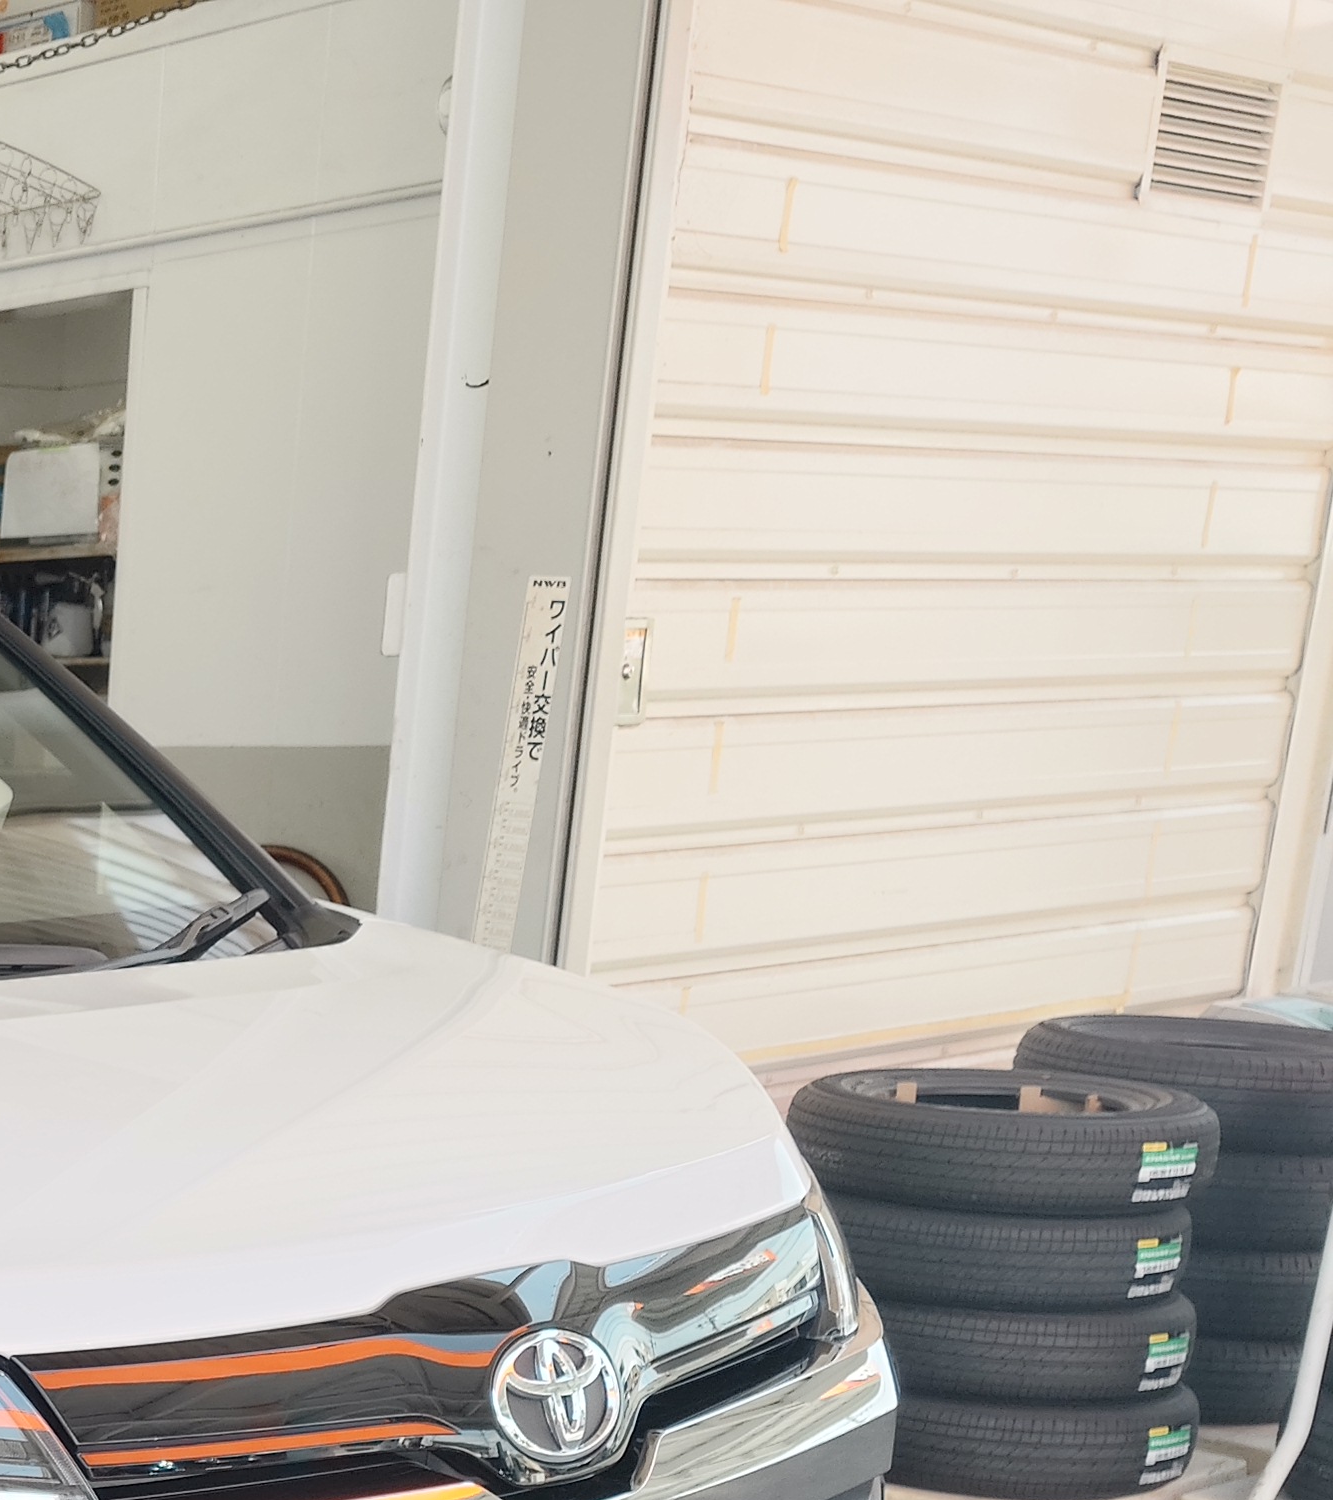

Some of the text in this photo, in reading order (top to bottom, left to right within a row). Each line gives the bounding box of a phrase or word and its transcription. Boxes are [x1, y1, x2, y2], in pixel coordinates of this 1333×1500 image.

[533, 580, 567, 588] NWB
[527, 599, 566, 761] ワイパー交換で
